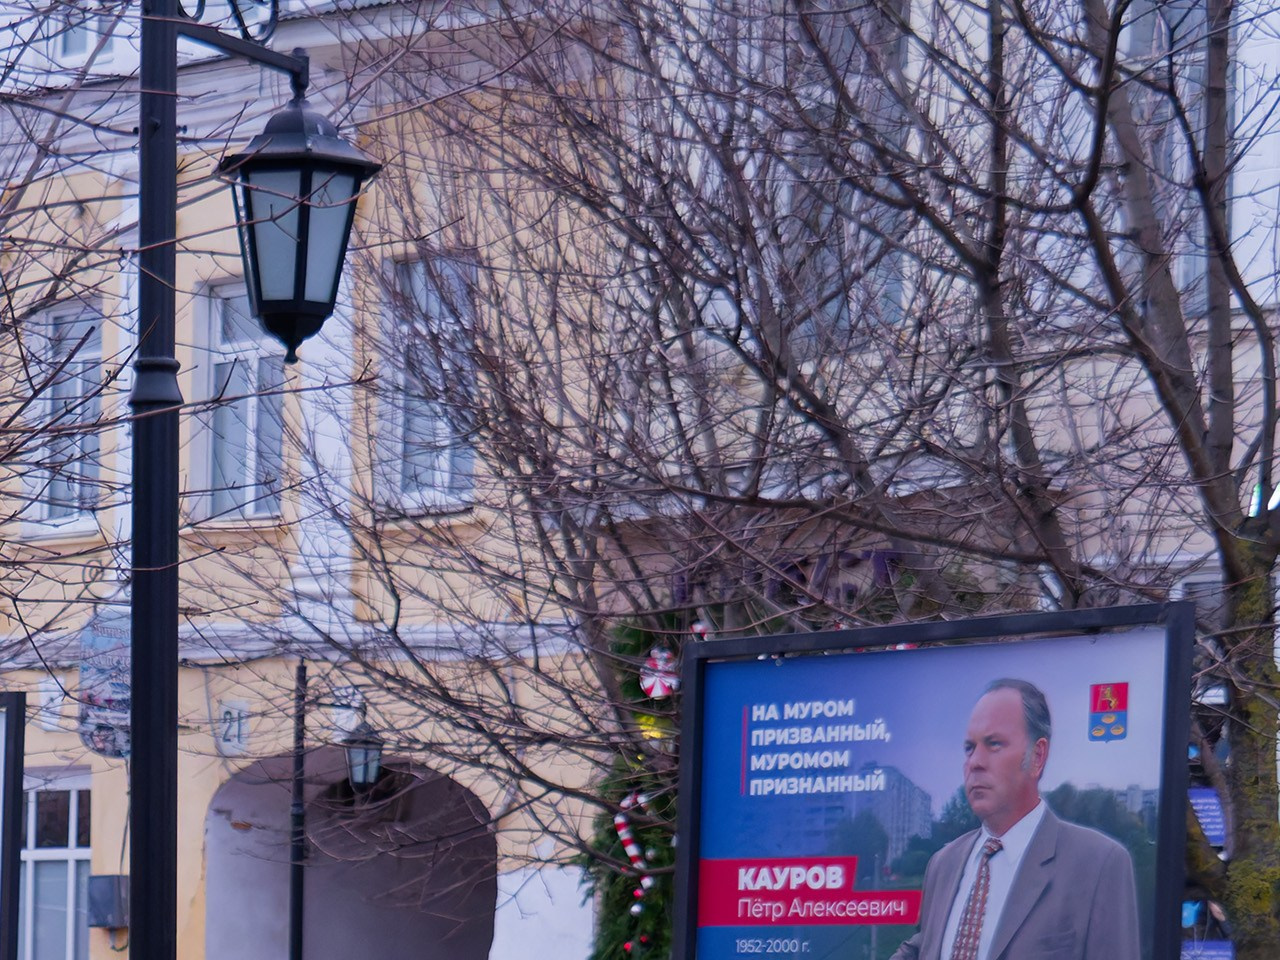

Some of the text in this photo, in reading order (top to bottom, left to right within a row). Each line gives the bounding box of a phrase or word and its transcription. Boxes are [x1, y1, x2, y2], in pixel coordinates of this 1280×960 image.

[752, 699, 855, 722] НА МУРОМ
[222, 710, 242, 744] 21
[751, 718, 891, 746] ПРИЗВАННЫЙ,
[750, 750, 850, 771] МУРОМОМ
[749, 769, 885, 796] ПРИЗНАННЫЙ
[737, 865, 844, 891] КАУРОВ
[737, 898, 905, 922] Пётр Алексеевич
[736, 940, 810, 954] 1952-2000 г.
